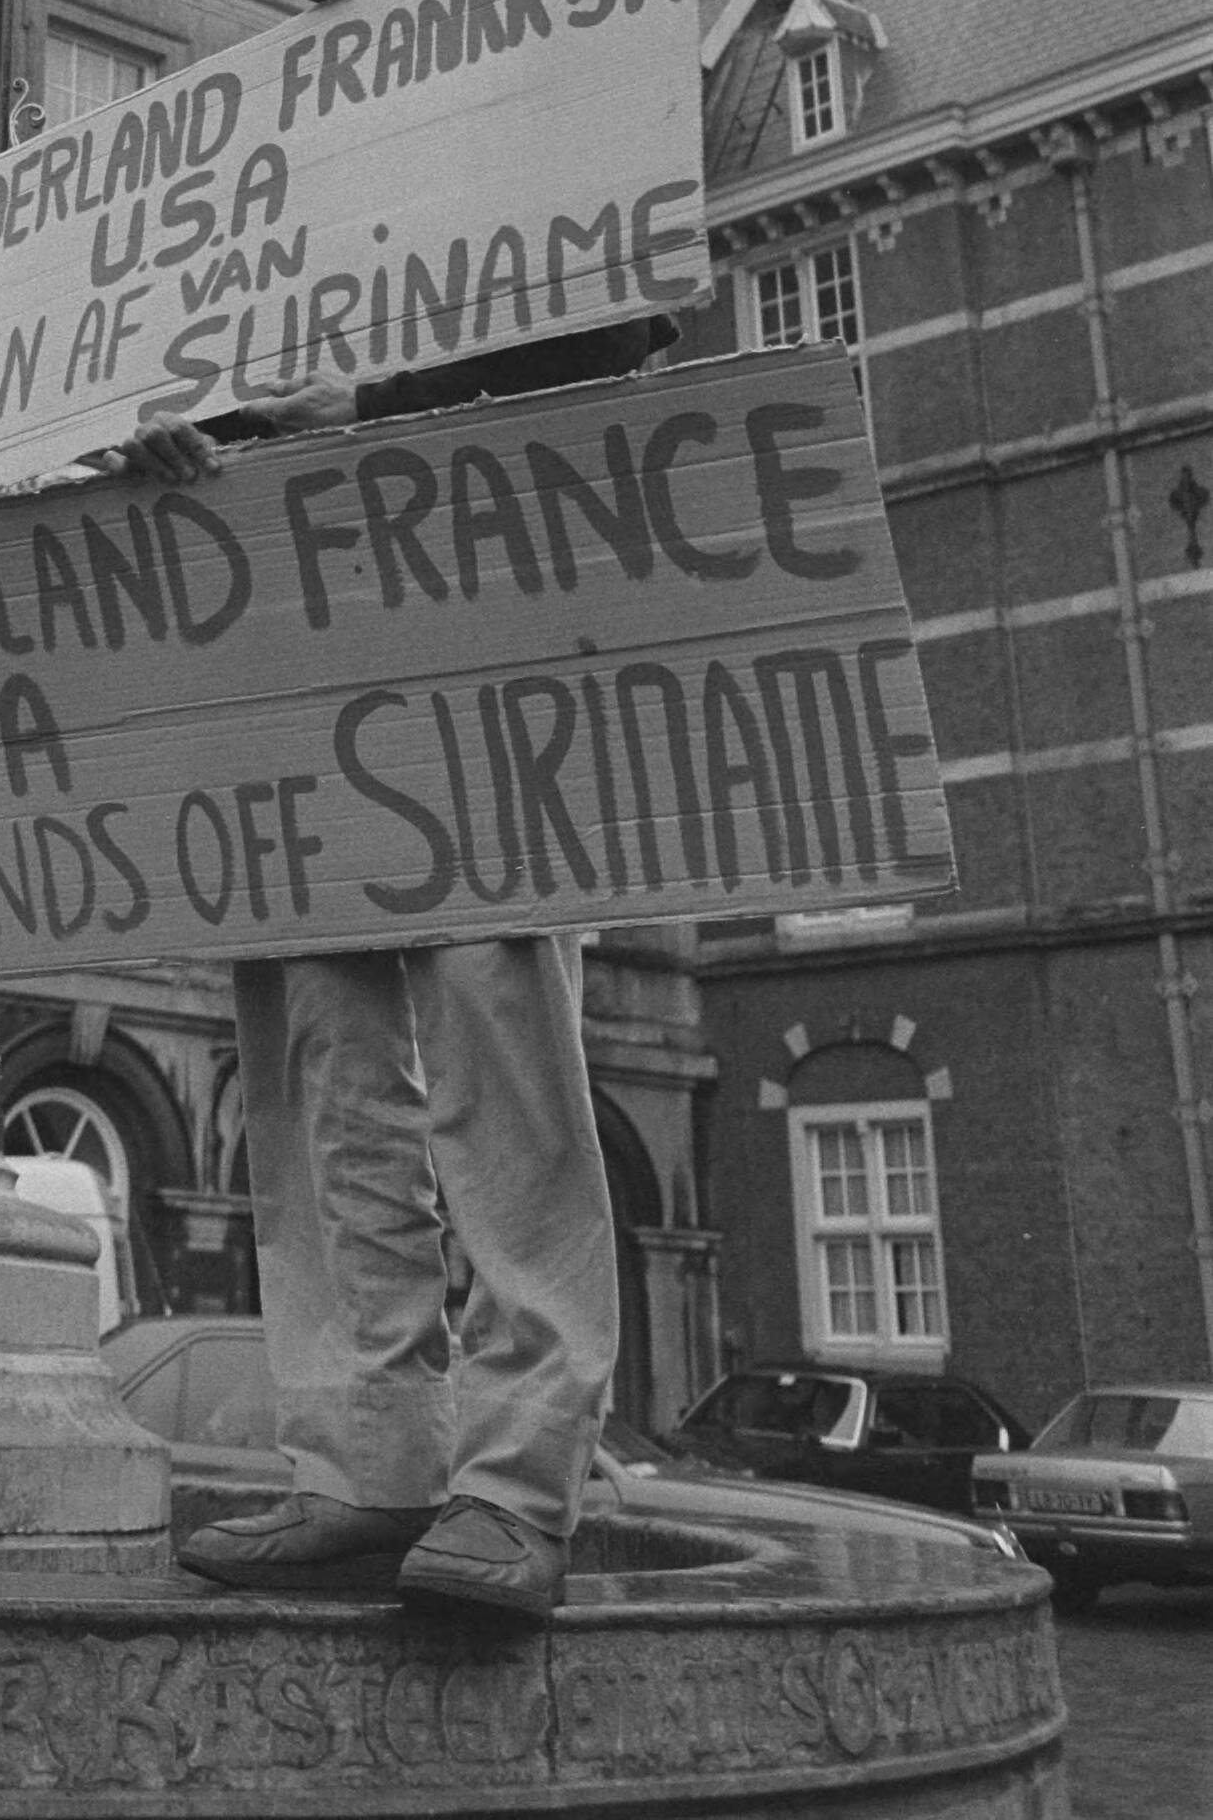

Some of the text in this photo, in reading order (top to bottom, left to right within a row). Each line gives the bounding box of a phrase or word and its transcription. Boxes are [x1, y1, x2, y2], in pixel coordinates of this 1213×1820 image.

[63, 285, 154, 396] AF
[183, 227, 305, 316] VAN
[138, 181, 705, 427] SURINAME
[283, 402, 867, 632] FRANCE
[175, 776, 324, 927] OFF
[334, 638, 932, 917] SURINAME
